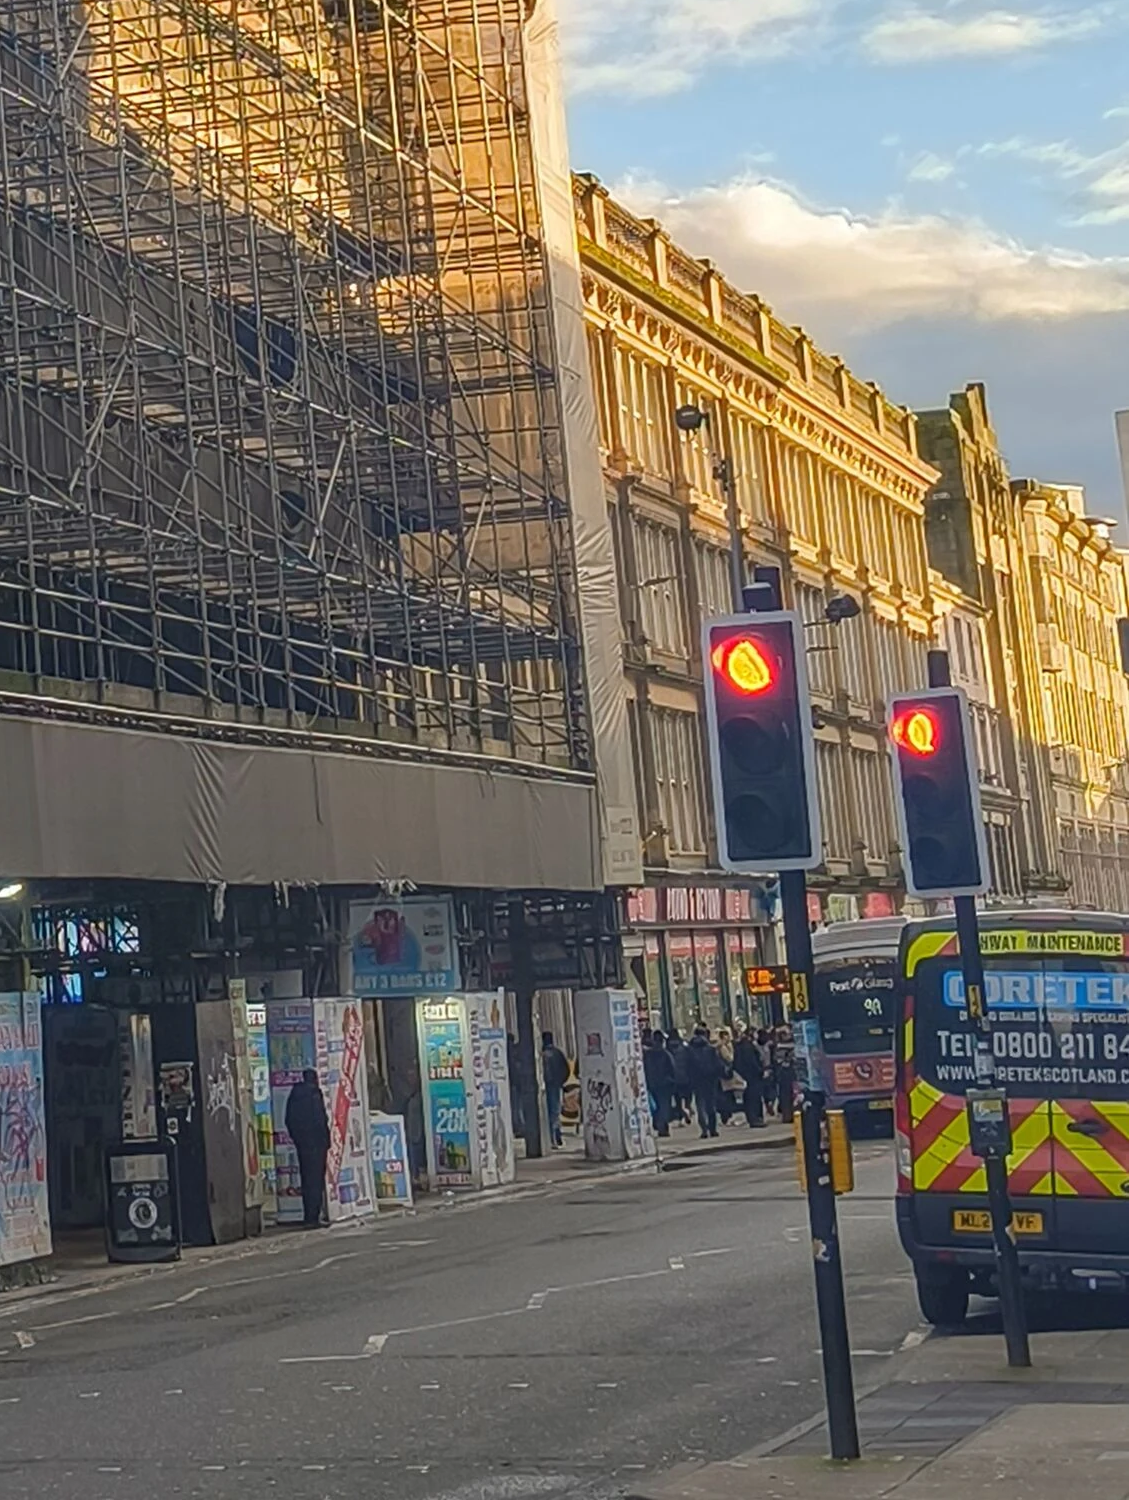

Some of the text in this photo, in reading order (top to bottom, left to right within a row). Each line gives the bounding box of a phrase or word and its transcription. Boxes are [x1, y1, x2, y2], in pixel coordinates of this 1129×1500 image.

[1026, 934, 1121, 952] MAINTENANCE
[993, 1031, 1053, 1059] 0800
[1060, 1032, 1094, 1060] 211
